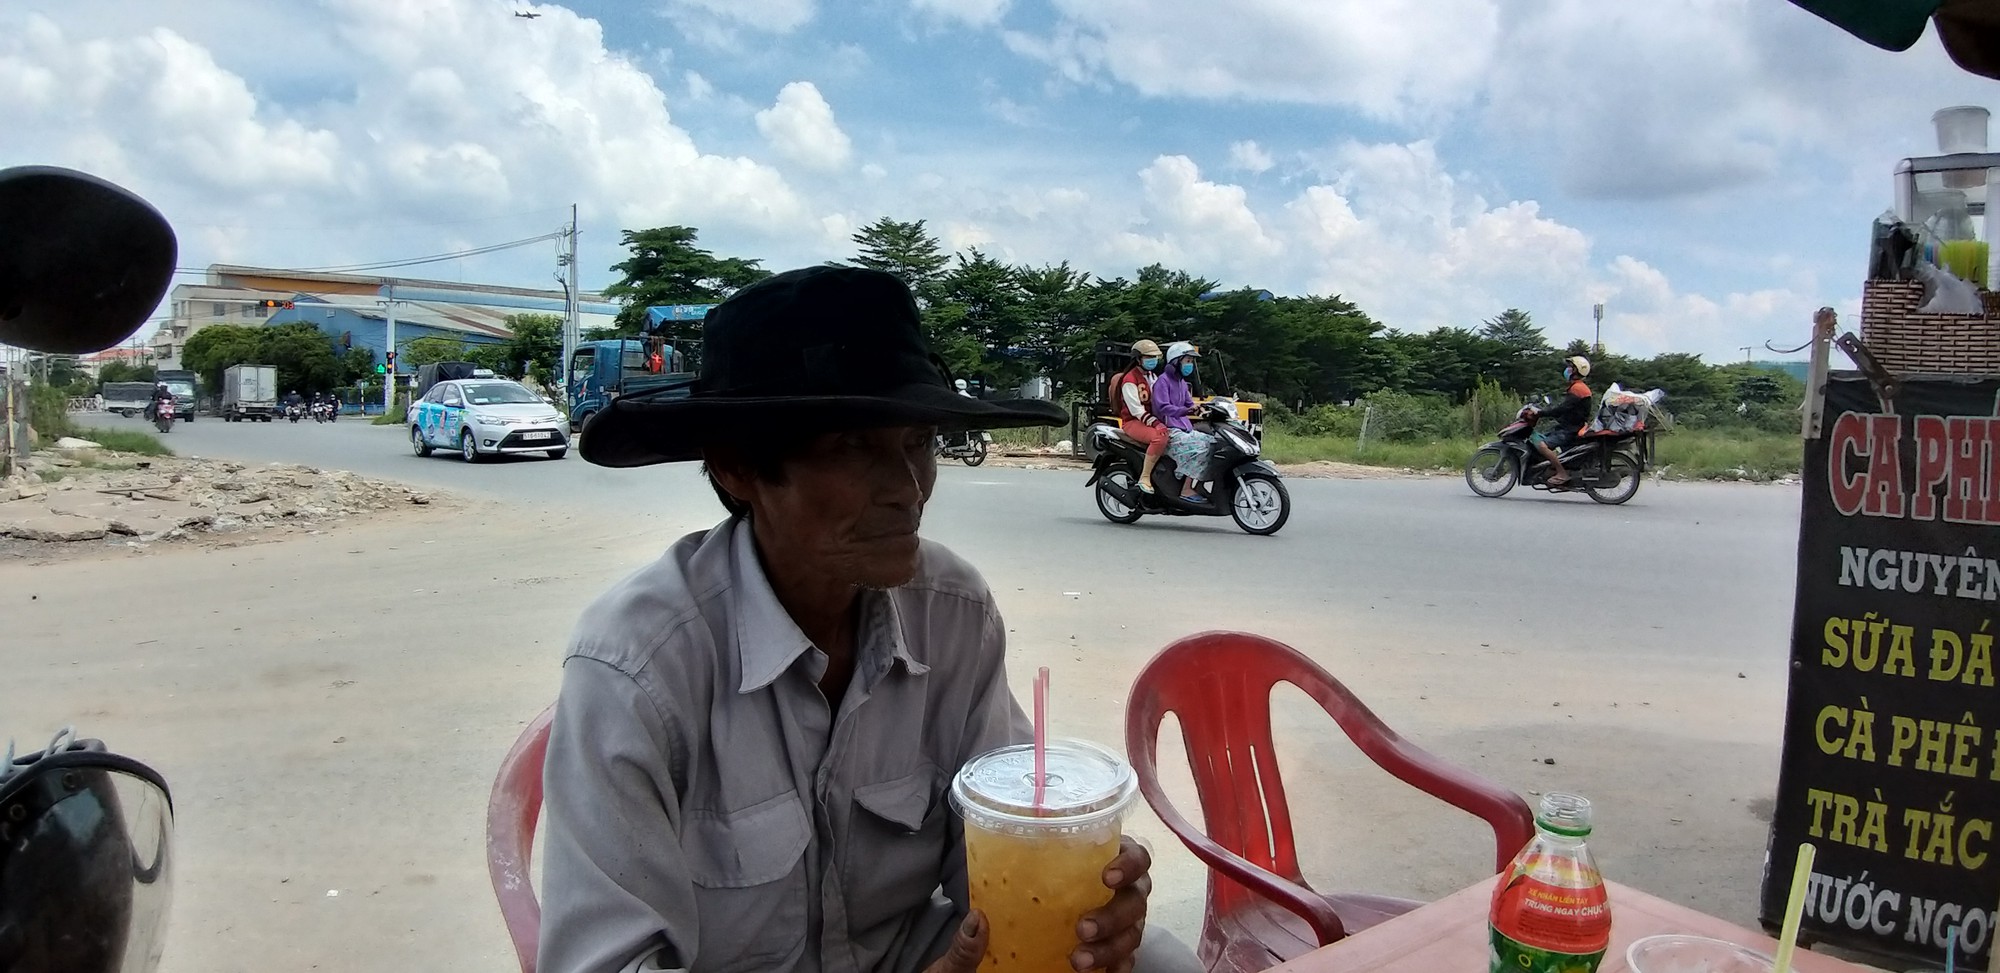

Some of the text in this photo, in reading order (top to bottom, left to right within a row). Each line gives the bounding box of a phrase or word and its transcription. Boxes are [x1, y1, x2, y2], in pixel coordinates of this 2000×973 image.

[1828, 400, 1905, 517] CÀ
[1822, 612, 1994, 687] SỮA ĐÁ
[1815, 696, 1875, 762] CÀ
[1887, 711, 1981, 777] PHÊ
[1807, 788, 1992, 869] TRÀ TẮC
[1554, 904, 1580, 916] NGAY
